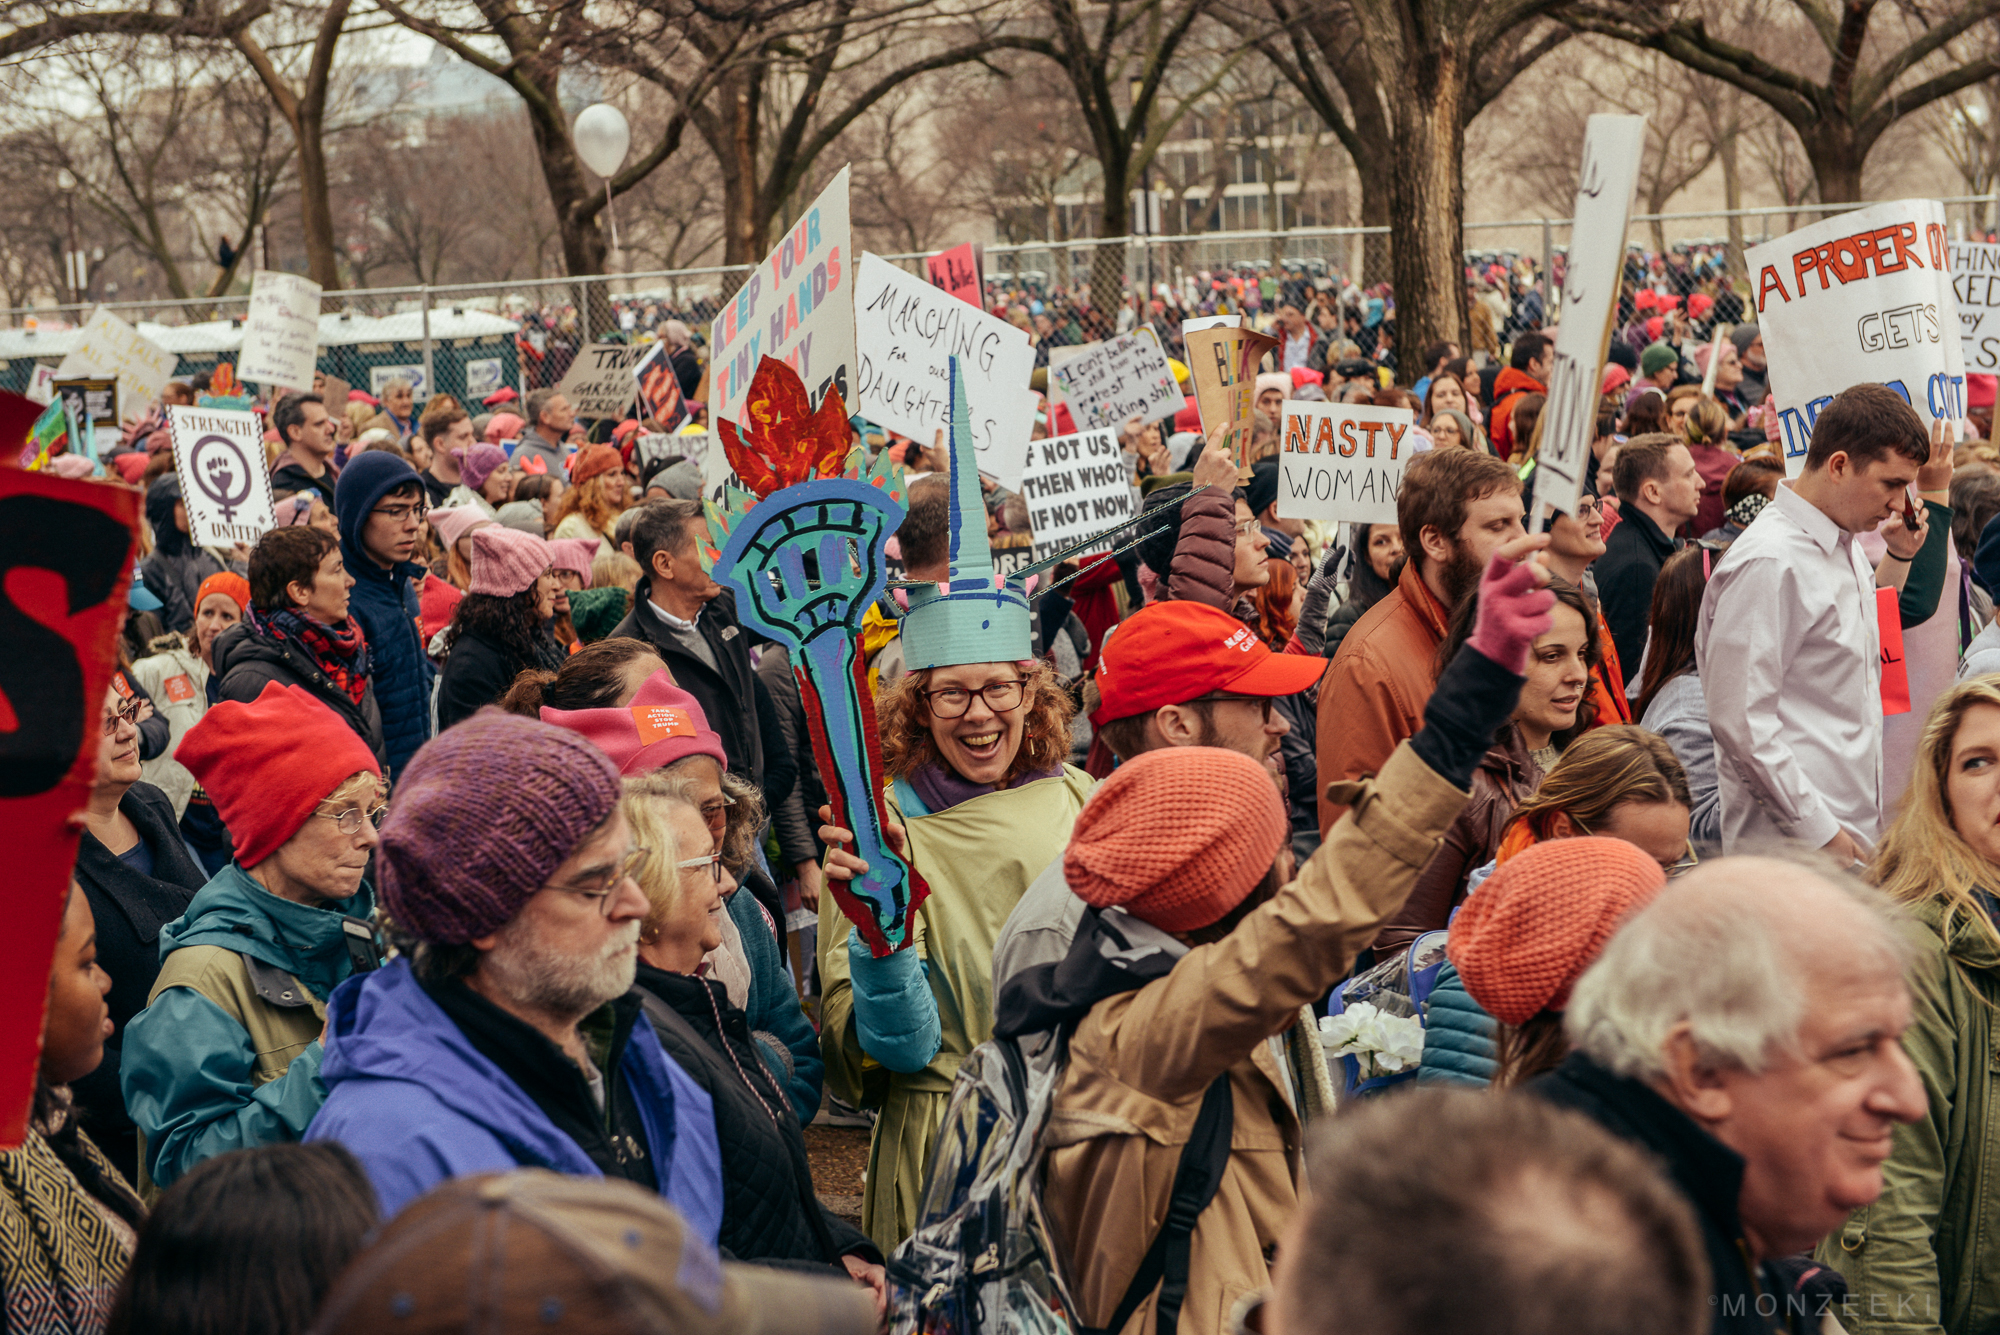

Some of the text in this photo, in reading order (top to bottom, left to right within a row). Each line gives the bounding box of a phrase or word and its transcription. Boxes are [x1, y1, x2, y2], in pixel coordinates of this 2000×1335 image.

[714, 207, 821, 360] KEEP YOUR
[1758, 264, 1791, 313] A
[1792, 221, 1925, 298] PROPER
[717, 328, 762, 410] TINY
[770, 245, 841, 355] HANDS
[866, 283, 1001, 381] MARCHING
[1857, 303, 1941, 353] GETS
[182, 415, 252, 437] STRENGTH
[1285, 414, 1408, 460] NASTY
[1042, 439, 1080, 466] NOT
[1086, 434, 1117, 458] US,
[1023, 462, 1124, 499] THEN WHO?
[1284, 465, 1400, 504] WOMAN
[211, 523, 263, 542] UNITED
[1031, 494, 1135, 531] IF NOT NOW,
